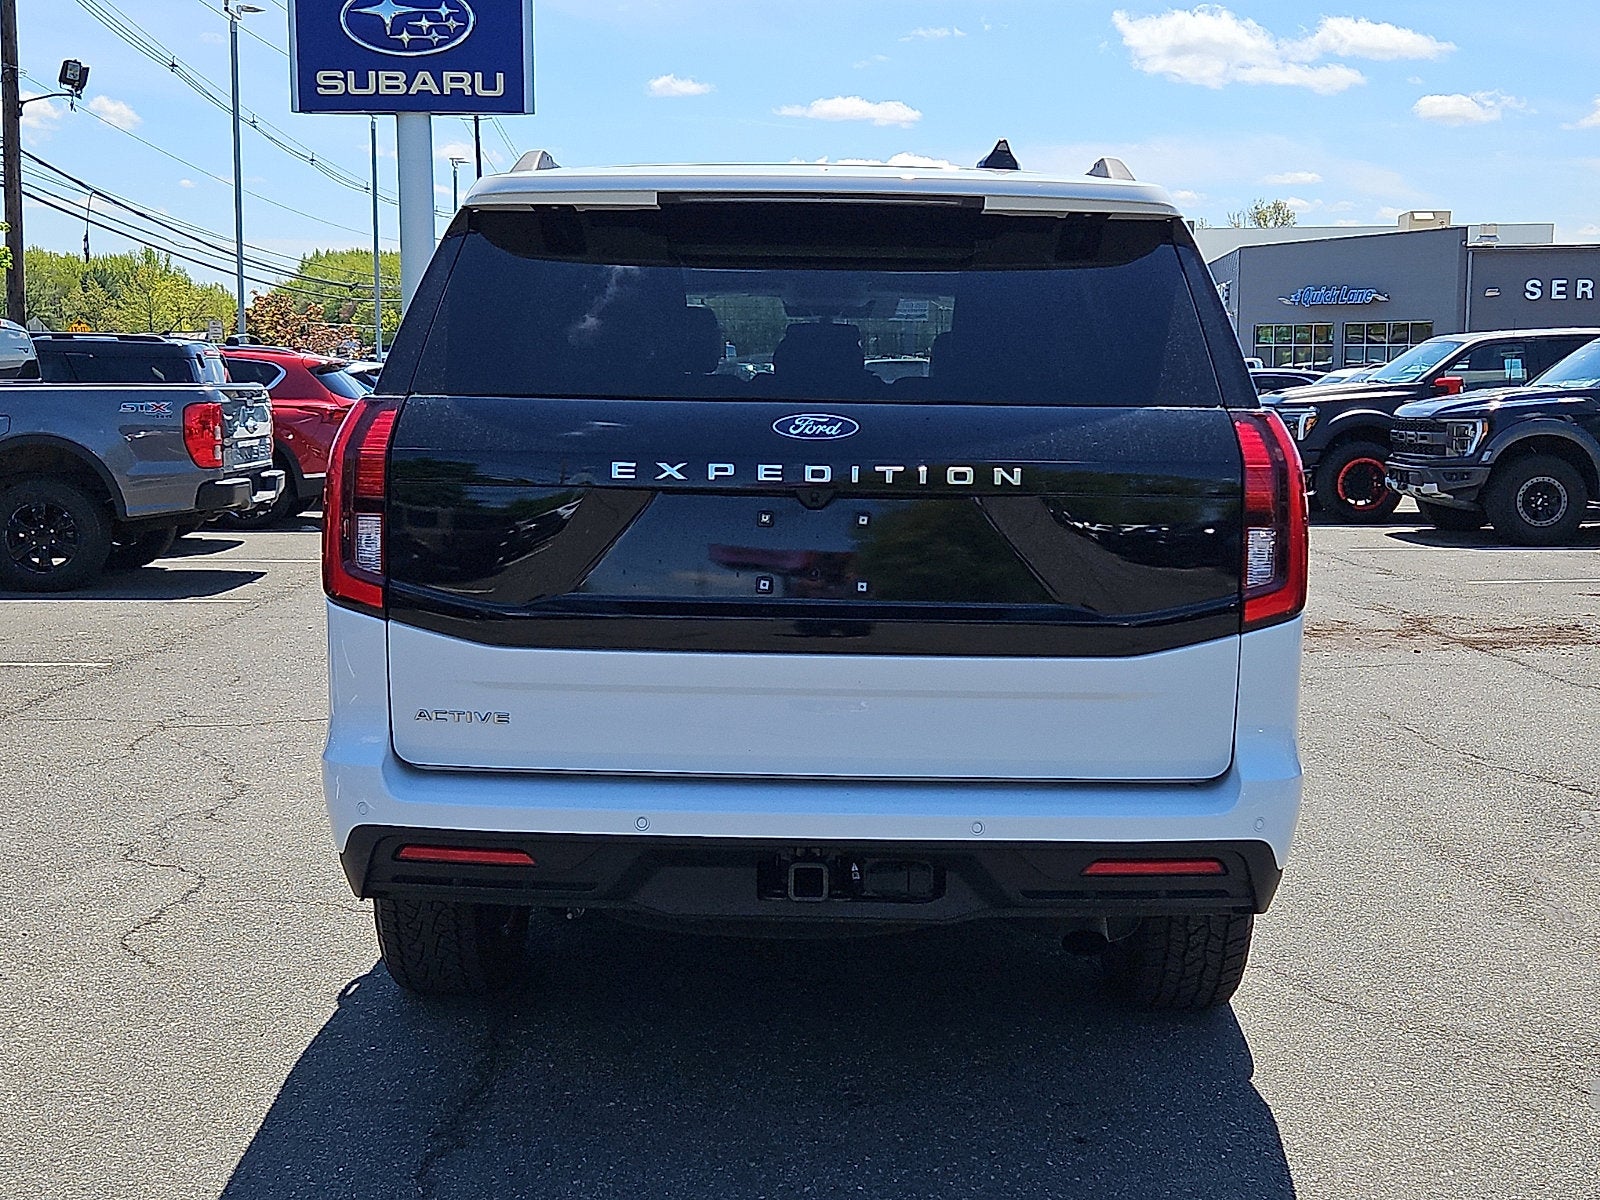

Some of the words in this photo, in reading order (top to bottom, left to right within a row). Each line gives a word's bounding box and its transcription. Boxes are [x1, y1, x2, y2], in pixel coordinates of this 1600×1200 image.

[316, 70, 505, 97] SUBARU
[1301, 286, 1339, 307] Quick
[1338, 285, 1376, 305] Lane
[789, 416, 843, 435] Ford
[611, 461, 1022, 486] EXPEDITION
[414, 708, 510, 724] ACTIVE
